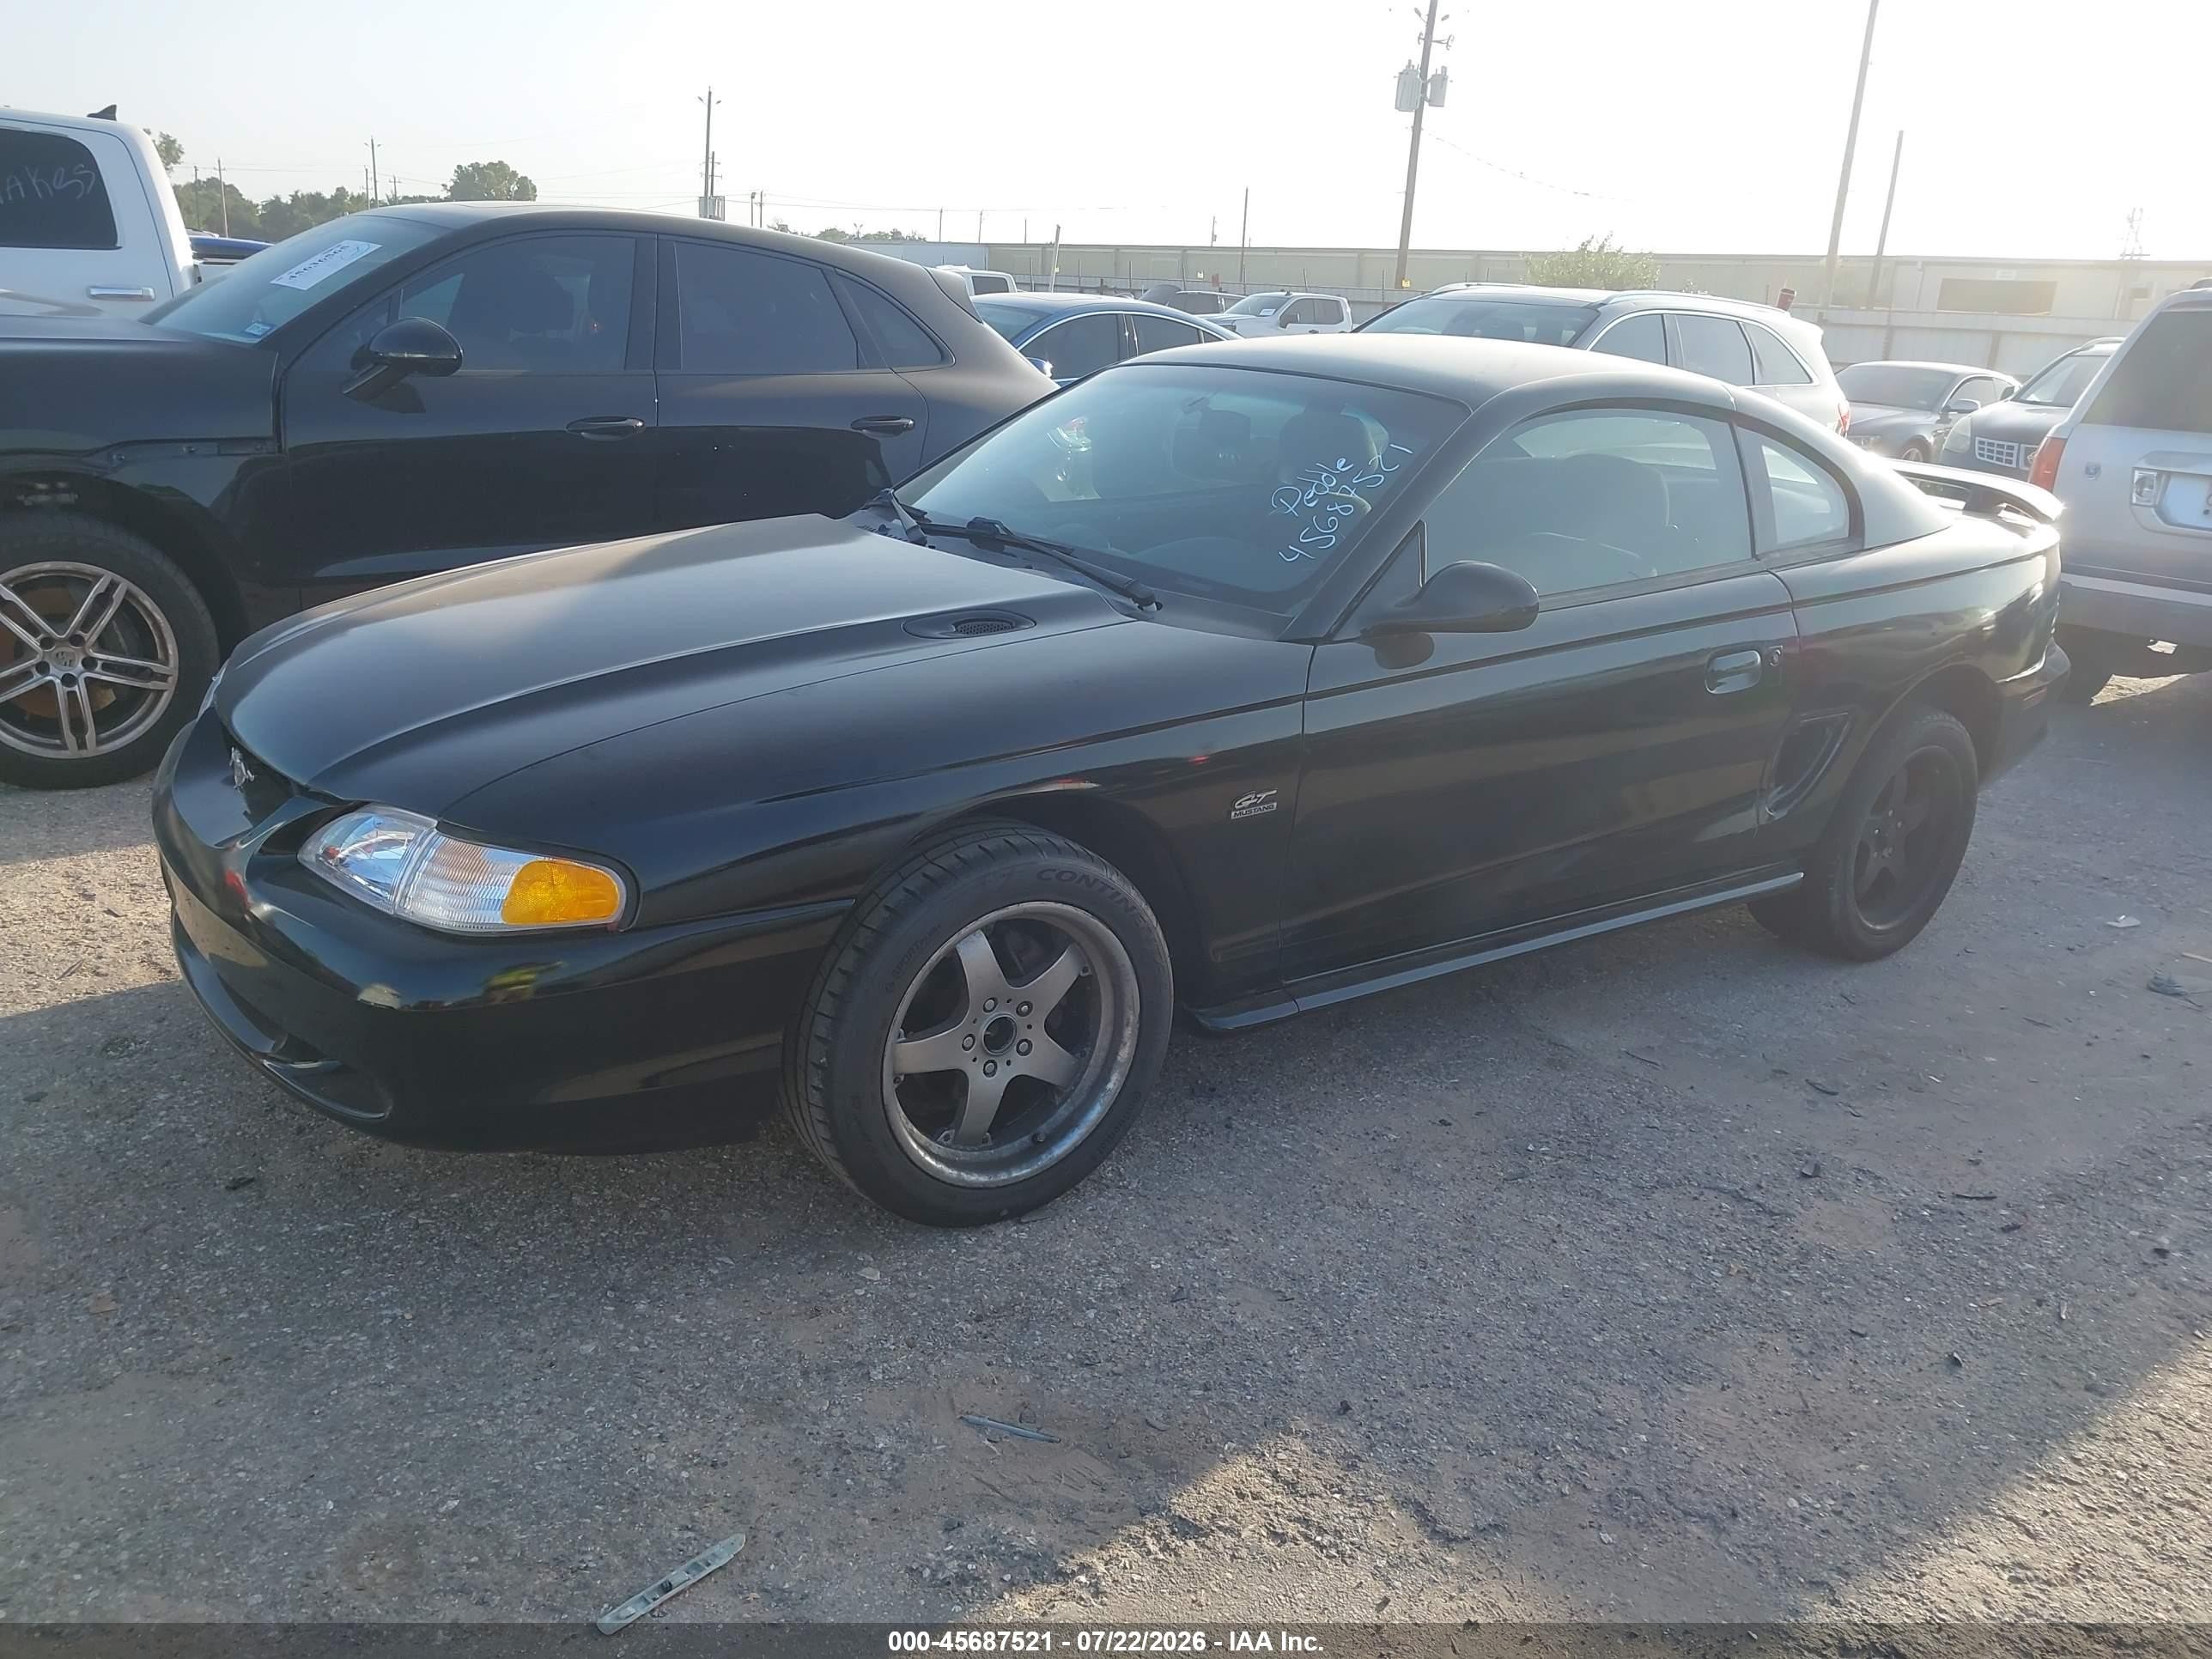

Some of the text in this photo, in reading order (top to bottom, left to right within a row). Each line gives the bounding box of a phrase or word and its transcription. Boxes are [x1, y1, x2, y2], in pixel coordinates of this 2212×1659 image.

[1278, 443, 1415, 562] 45687521
[1234, 789, 1278, 809] GT
[1232, 803, 1276, 818] MUSTANG
